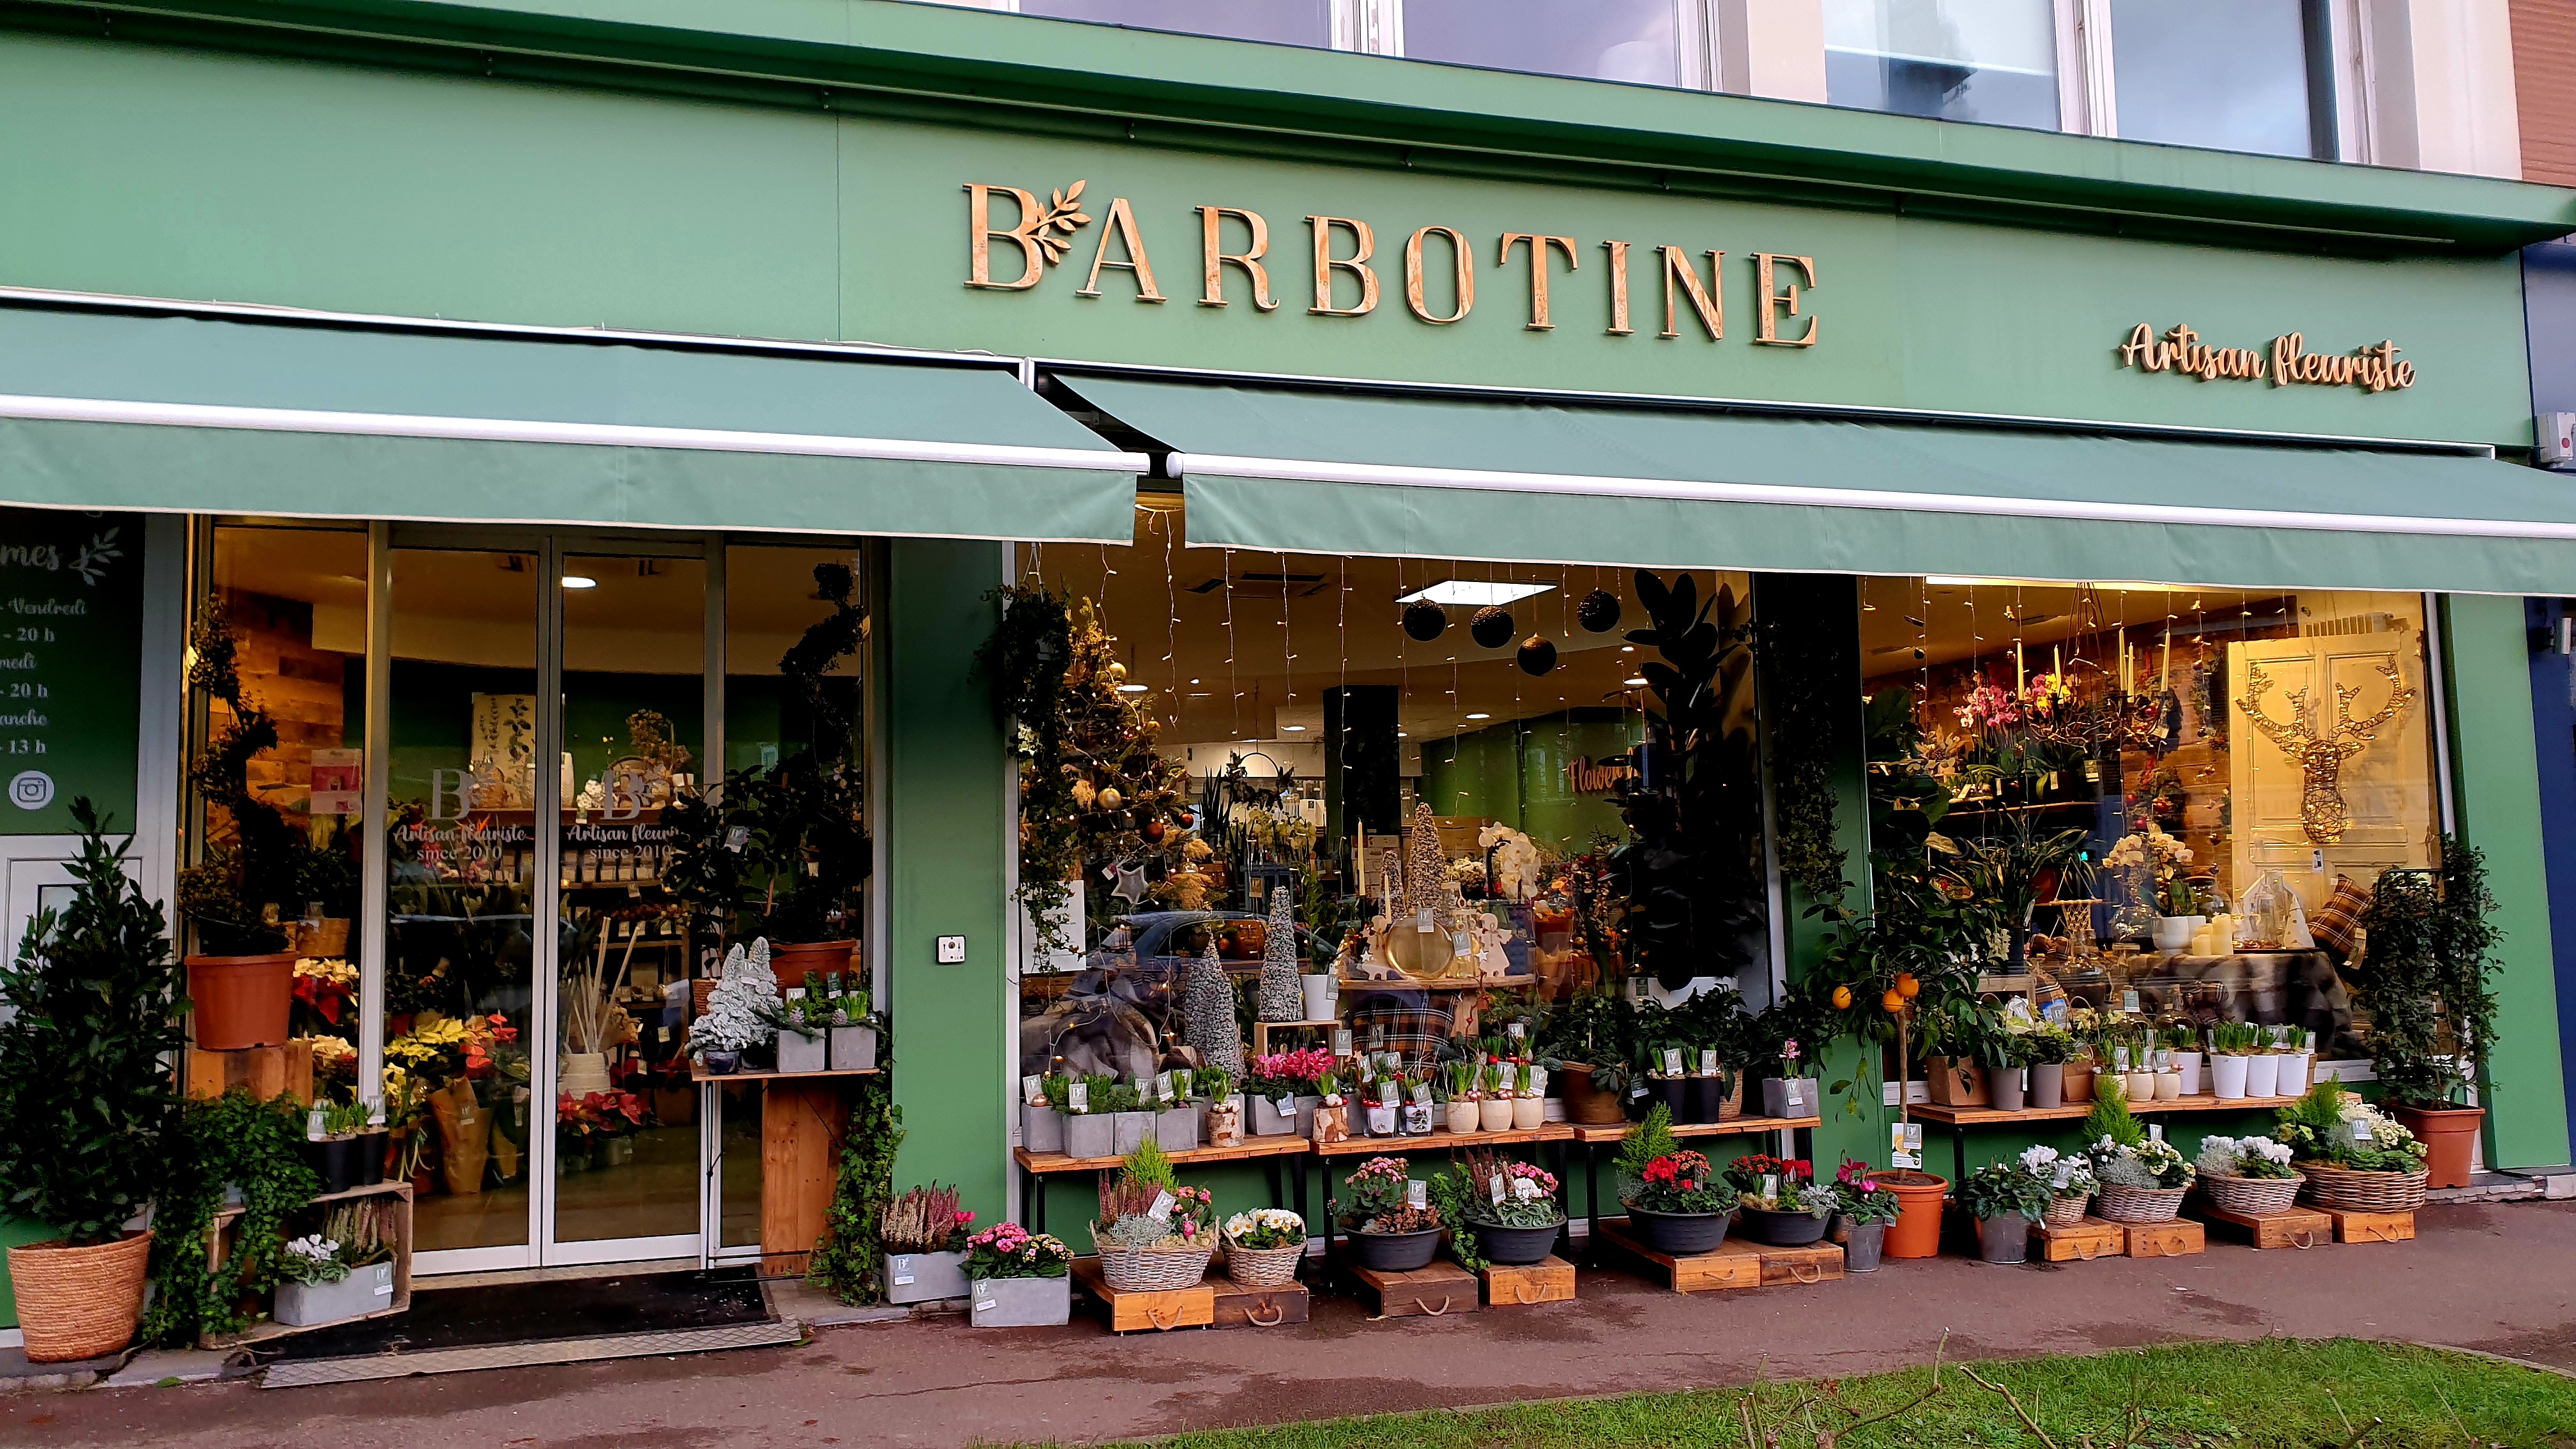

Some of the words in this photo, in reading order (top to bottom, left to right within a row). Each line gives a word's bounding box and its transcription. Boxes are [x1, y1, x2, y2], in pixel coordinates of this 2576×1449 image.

[963, 181, 1818, 347] BARBOTINE
[2120, 322, 2266, 381] Artisan
[2271, 332, 2417, 392] fleuriste
[10, 683, 31, 698] 20
[10, 740, 29, 755] 13
[393, 824, 456, 843] Artisan
[566, 824, 629, 843] Artisan
[463, 845, 502, 860] 2010
[590, 845, 629, 859] since
[633, 845, 671, 859] 2010
